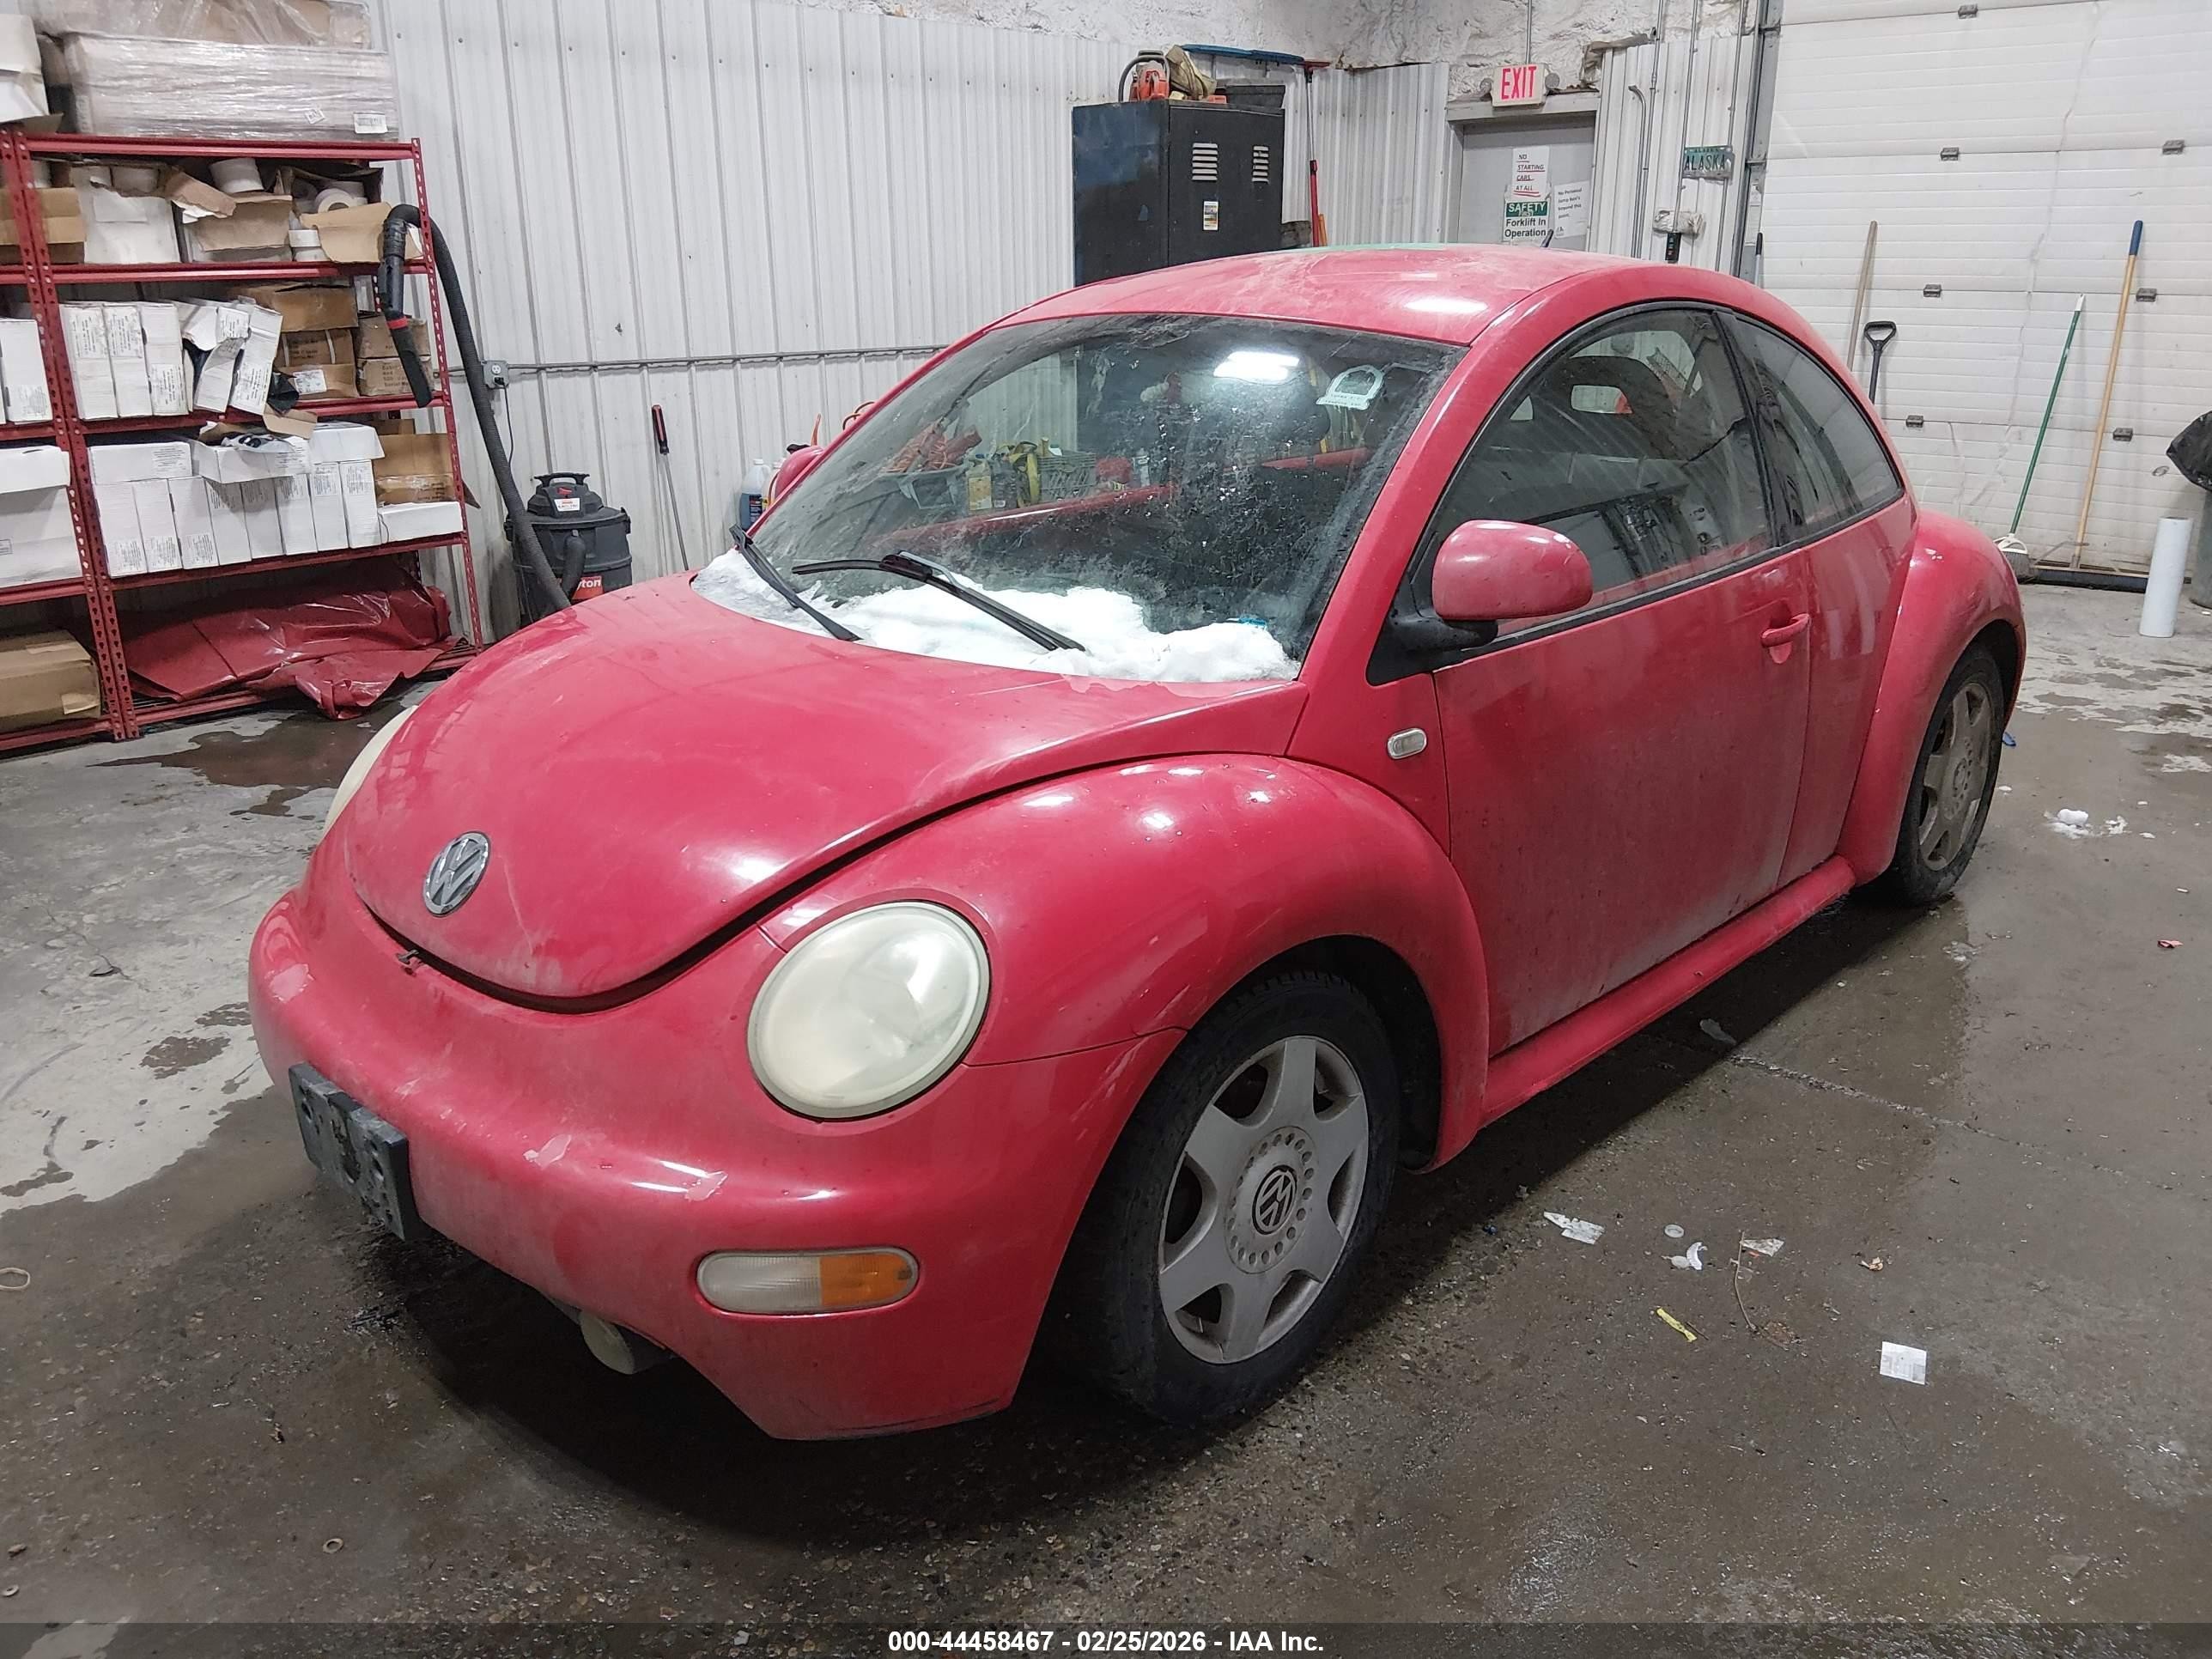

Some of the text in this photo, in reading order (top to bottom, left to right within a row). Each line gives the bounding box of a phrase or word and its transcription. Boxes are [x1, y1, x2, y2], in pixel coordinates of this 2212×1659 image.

[1501, 65, 1537, 100] EXIT
[1683, 155, 1725, 171] ALASKA
[1508, 203, 1546, 213] SAFETY
[1505, 218, 1536, 227] Forklift
[1504, 228, 1547, 240] Operation
